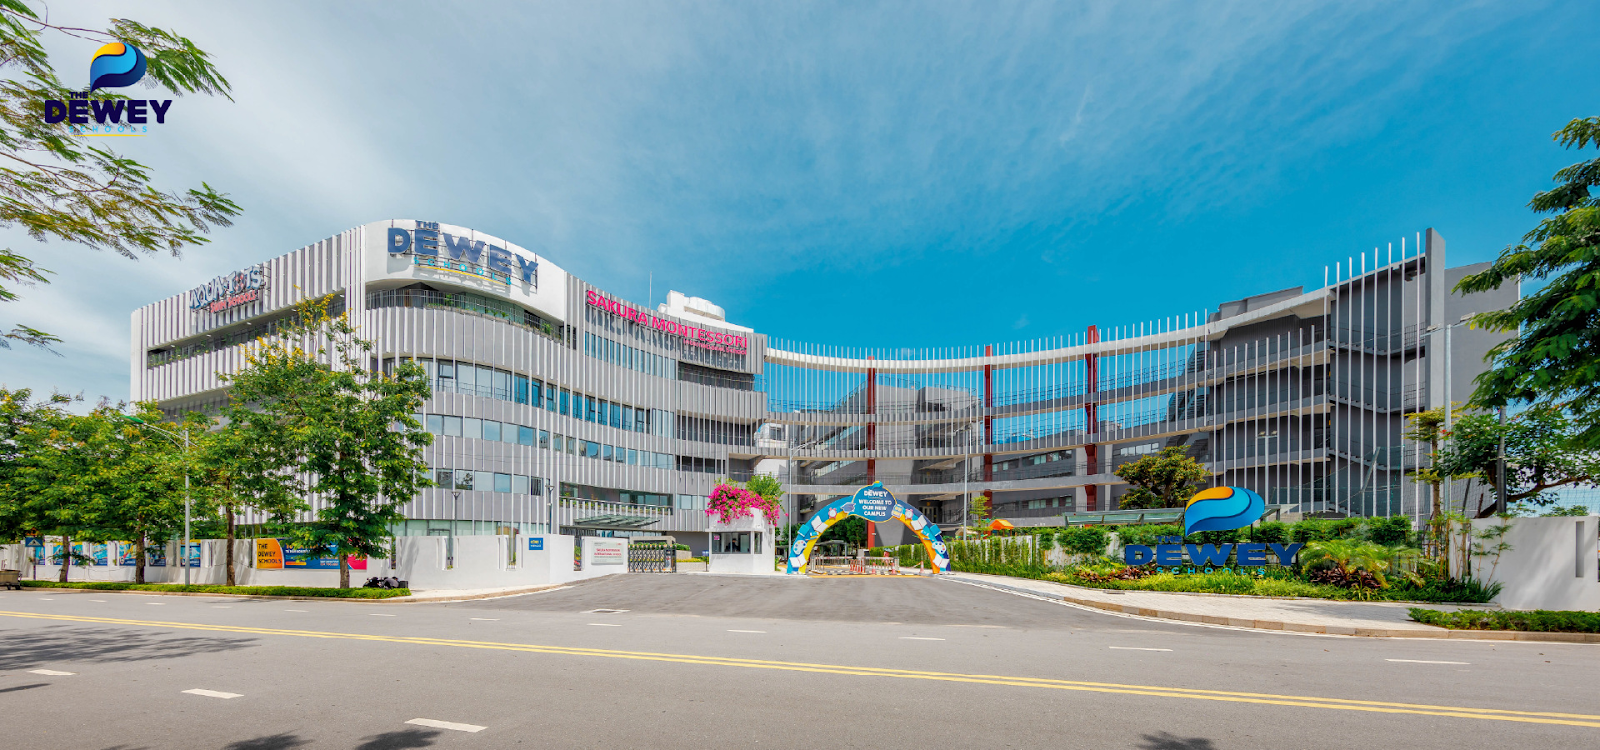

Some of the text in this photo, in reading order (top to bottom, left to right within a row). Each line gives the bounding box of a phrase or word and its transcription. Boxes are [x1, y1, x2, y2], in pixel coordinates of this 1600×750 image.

[415, 220, 439, 230] THE
[387, 227, 539, 283] DEWEY
[413, 256, 512, 286] SCHOOLS
[210, 290, 256, 313] SWIM SCHOOLS
[586, 290, 747, 349] SAKURA MONTESSORI
[1156, 535, 1182, 543] THE
[1125, 543, 1304, 566] DEWEY
[1157, 567, 1265, 575] SCHOOLS
